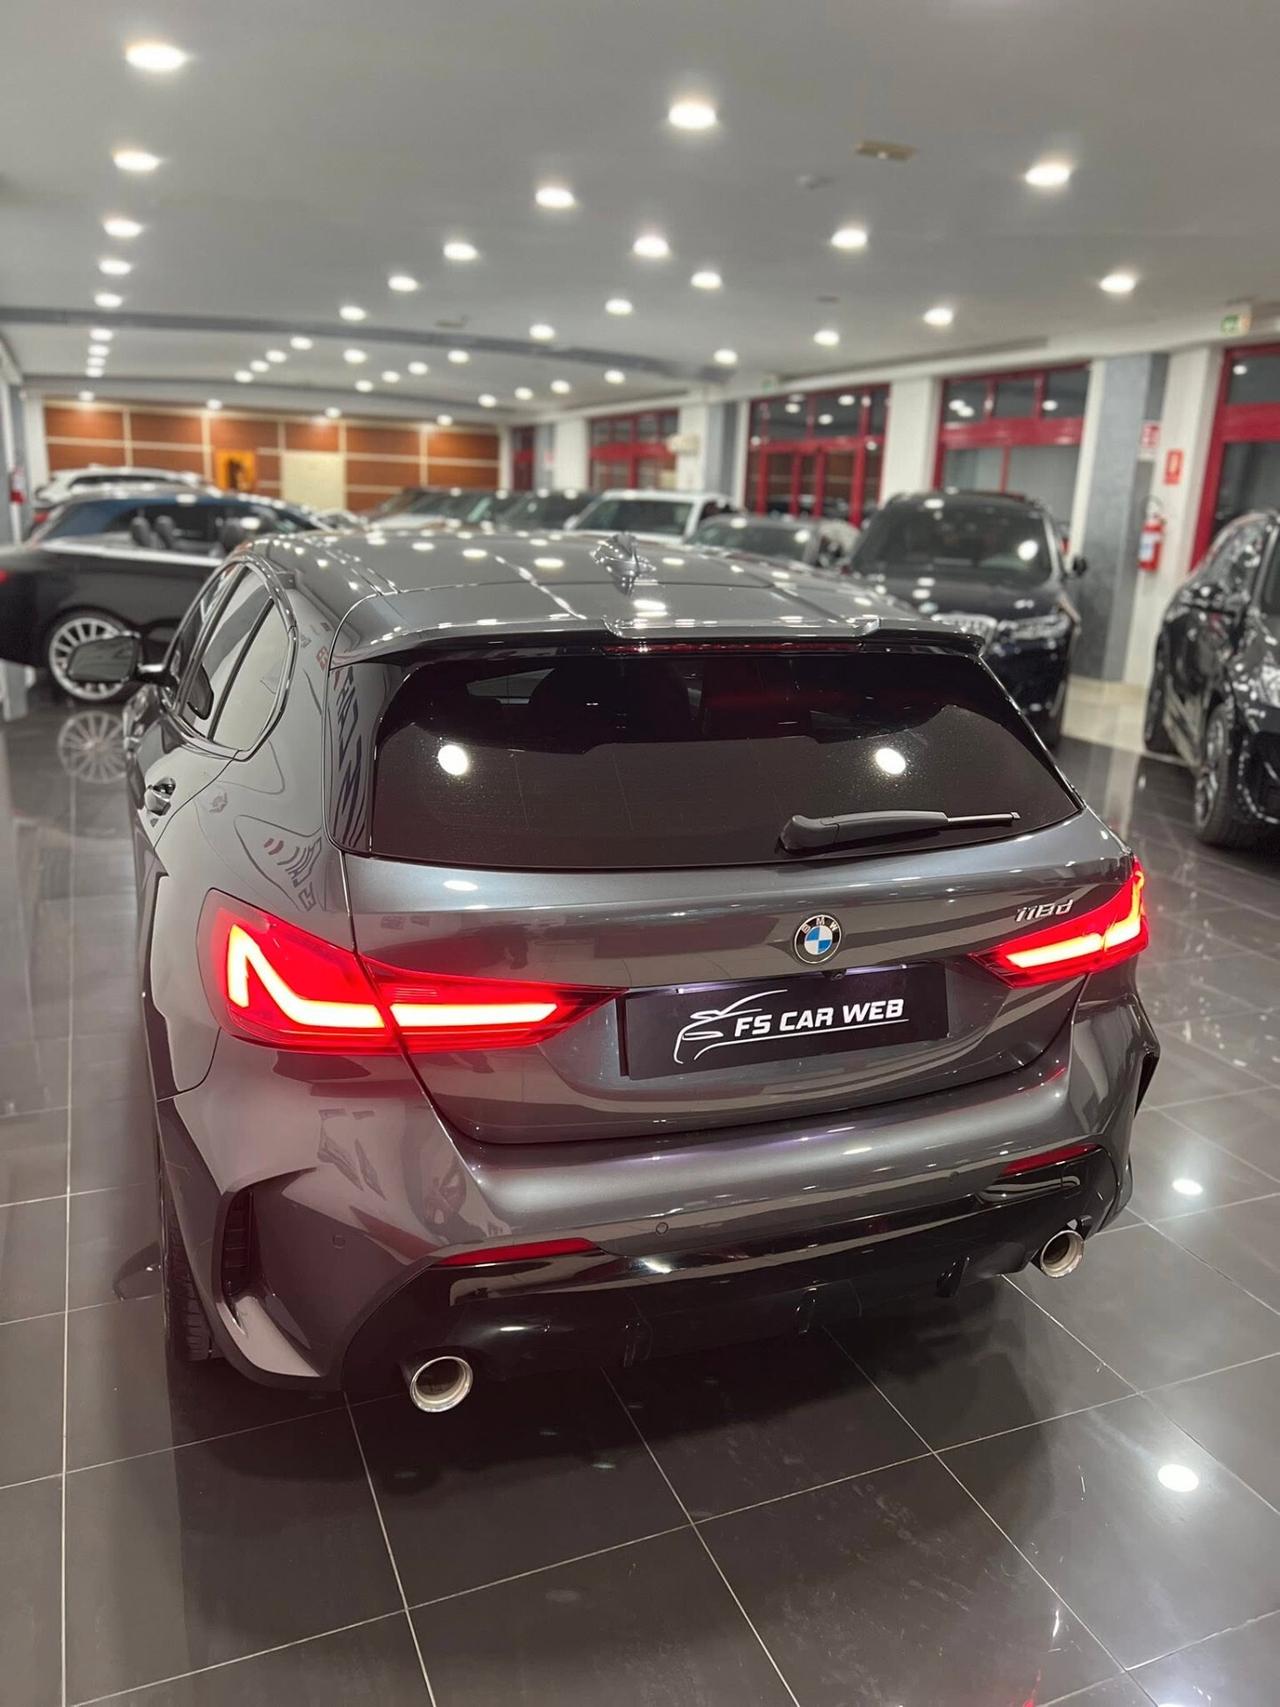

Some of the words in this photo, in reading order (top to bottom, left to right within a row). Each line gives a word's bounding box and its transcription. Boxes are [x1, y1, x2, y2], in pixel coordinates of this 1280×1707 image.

[1016, 899, 1073, 922] 118d
[801, 916, 839, 934] BMW
[734, 1014, 772, 1037] FS
[779, 1007, 834, 1032] CAR
[842, 998, 904, 1024] WEB
